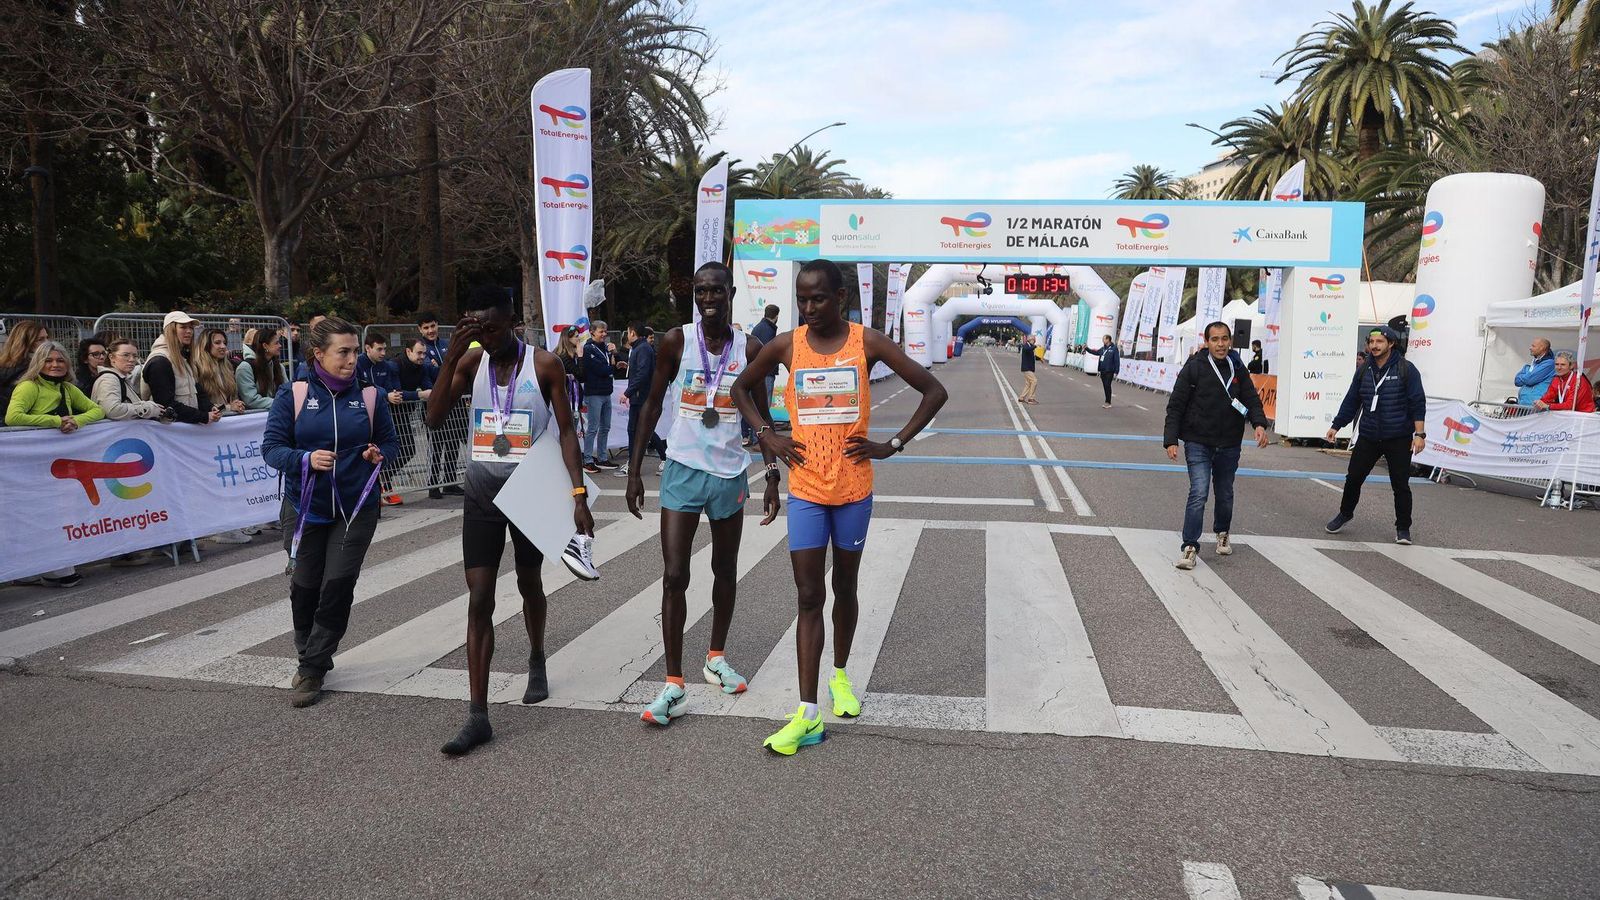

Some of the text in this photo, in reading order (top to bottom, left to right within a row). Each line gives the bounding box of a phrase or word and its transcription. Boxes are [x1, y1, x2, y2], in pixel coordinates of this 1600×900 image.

[540, 128, 588, 141] TotalEnergies
[1007, 215, 1102, 230] 1/2 MARATÓN
[1006, 232, 1090, 248] DE MÁLAGA
[1256, 228, 1308, 240] CaixaBank
[940, 241, 991, 250] TotalEnergies
[1116, 243, 1169, 252] TotalEnergies
[1007, 278, 1068, 292] 01:01:34
[1303, 371, 1323, 380] UAX
[825, 394, 834, 408] 2
[63, 509, 169, 541] TotalEnergies
